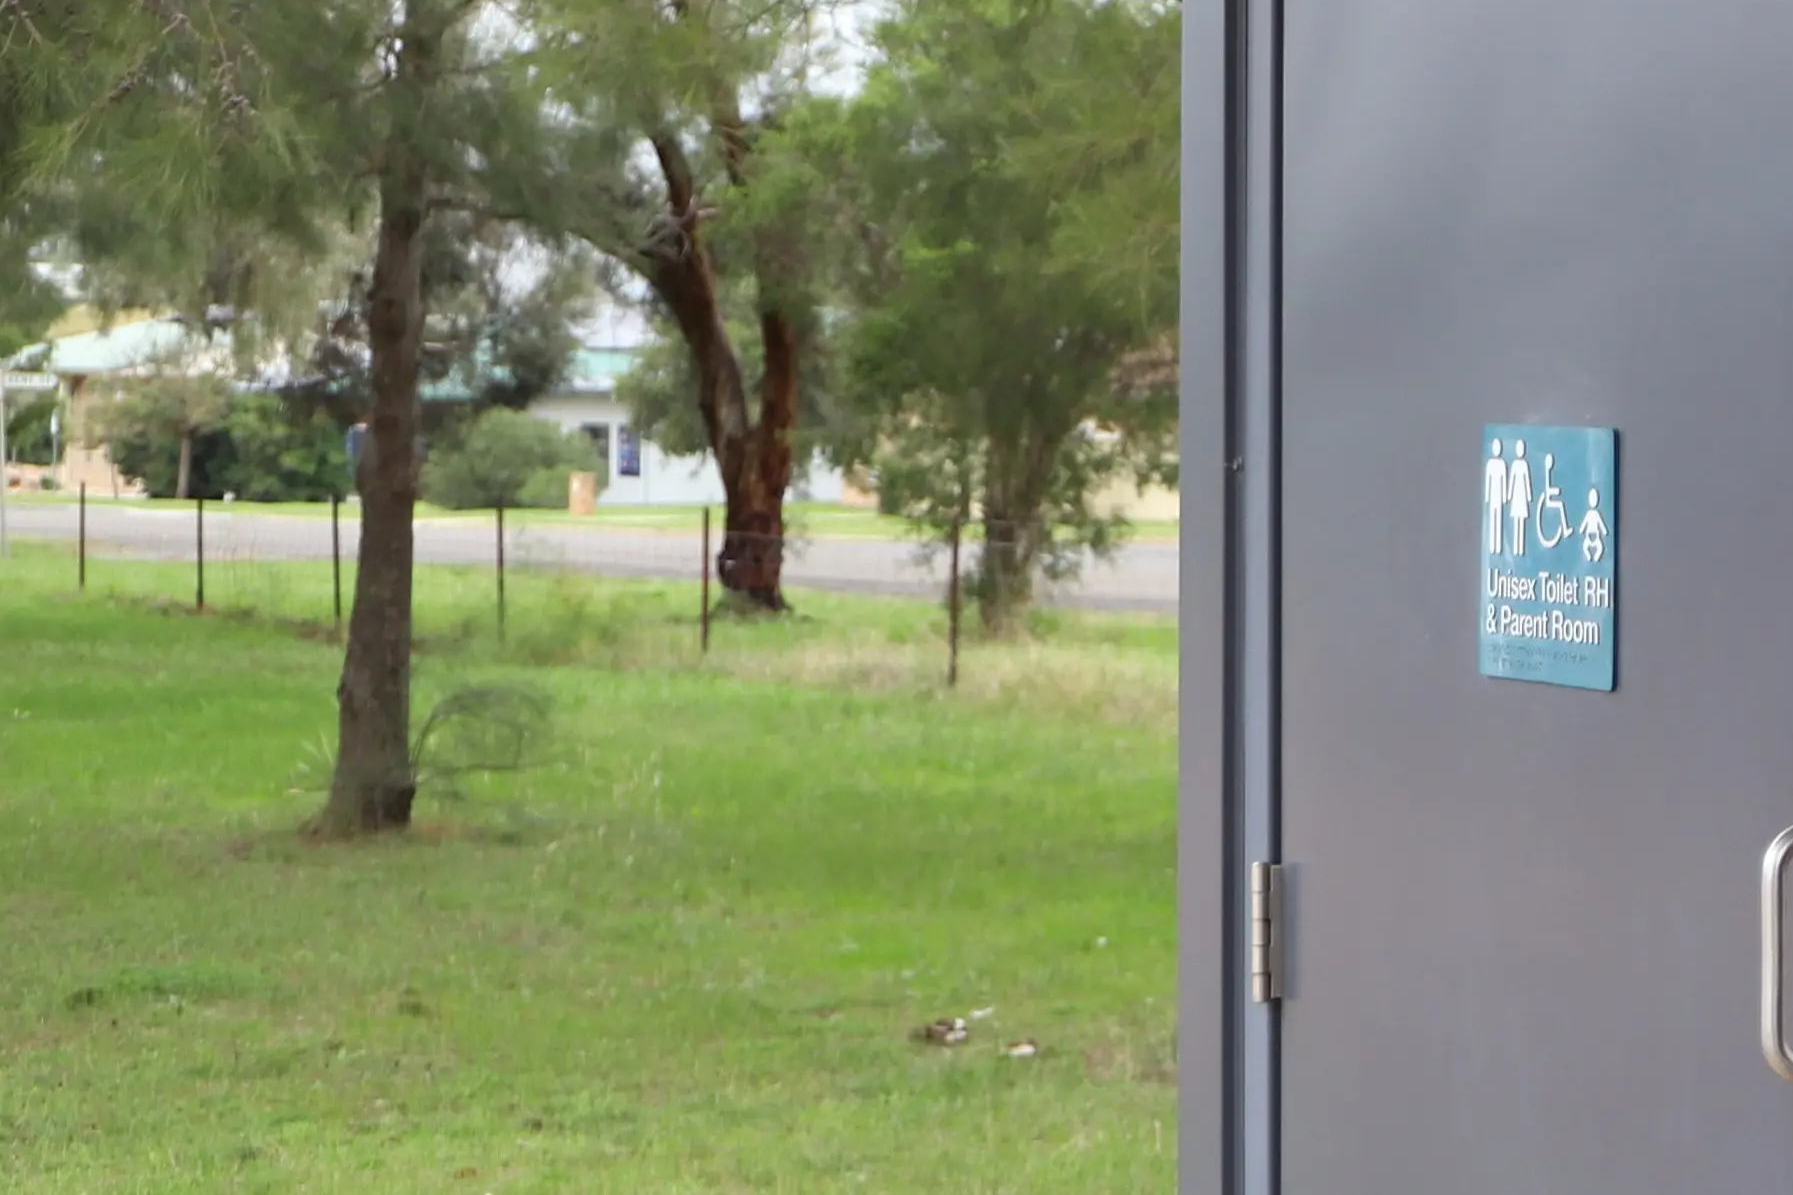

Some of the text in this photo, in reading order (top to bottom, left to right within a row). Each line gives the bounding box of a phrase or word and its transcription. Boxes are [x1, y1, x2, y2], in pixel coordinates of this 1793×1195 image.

[1487, 568, 1611, 609] Unisex Toilet RH
[1486, 603, 1601, 646] & Parent Room
